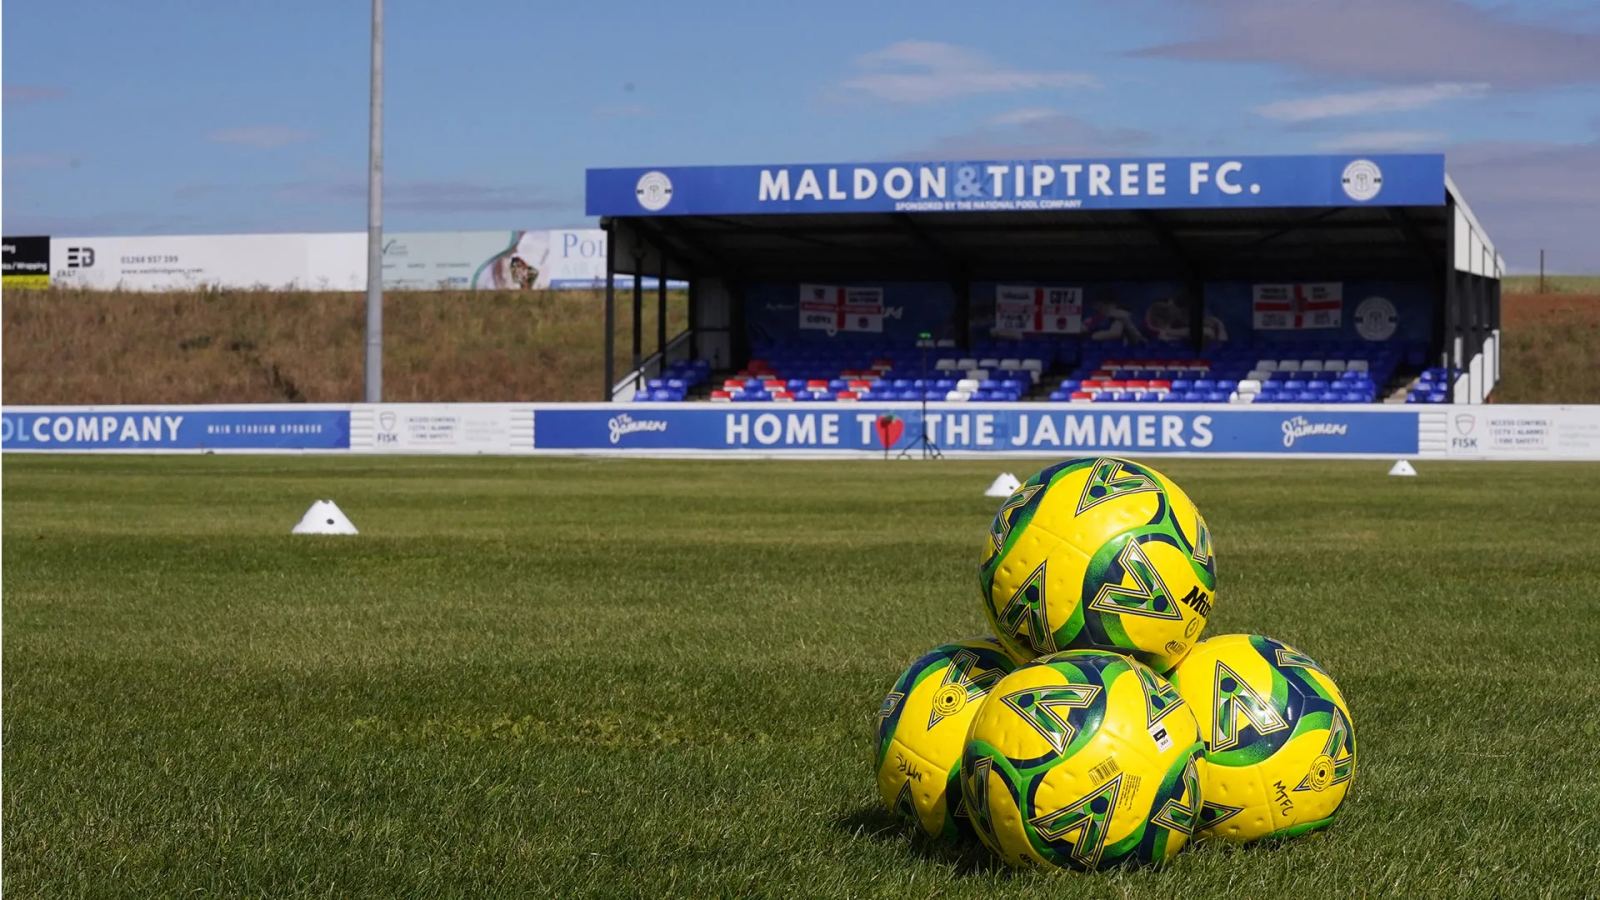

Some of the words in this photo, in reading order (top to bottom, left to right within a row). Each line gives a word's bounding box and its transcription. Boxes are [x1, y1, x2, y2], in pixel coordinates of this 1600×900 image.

[1189, 161, 1261, 195] FC.
[378, 433, 398, 442] FISK
[726, 413, 839, 445] HOME
[924, 413, 994, 446] THE
[1010, 414, 1214, 447] JAMMERS
[1282, 420, 1348, 447] Jammers
[1453, 438, 1478, 448] FISK
[1273, 780, 1294, 817] MTFC
